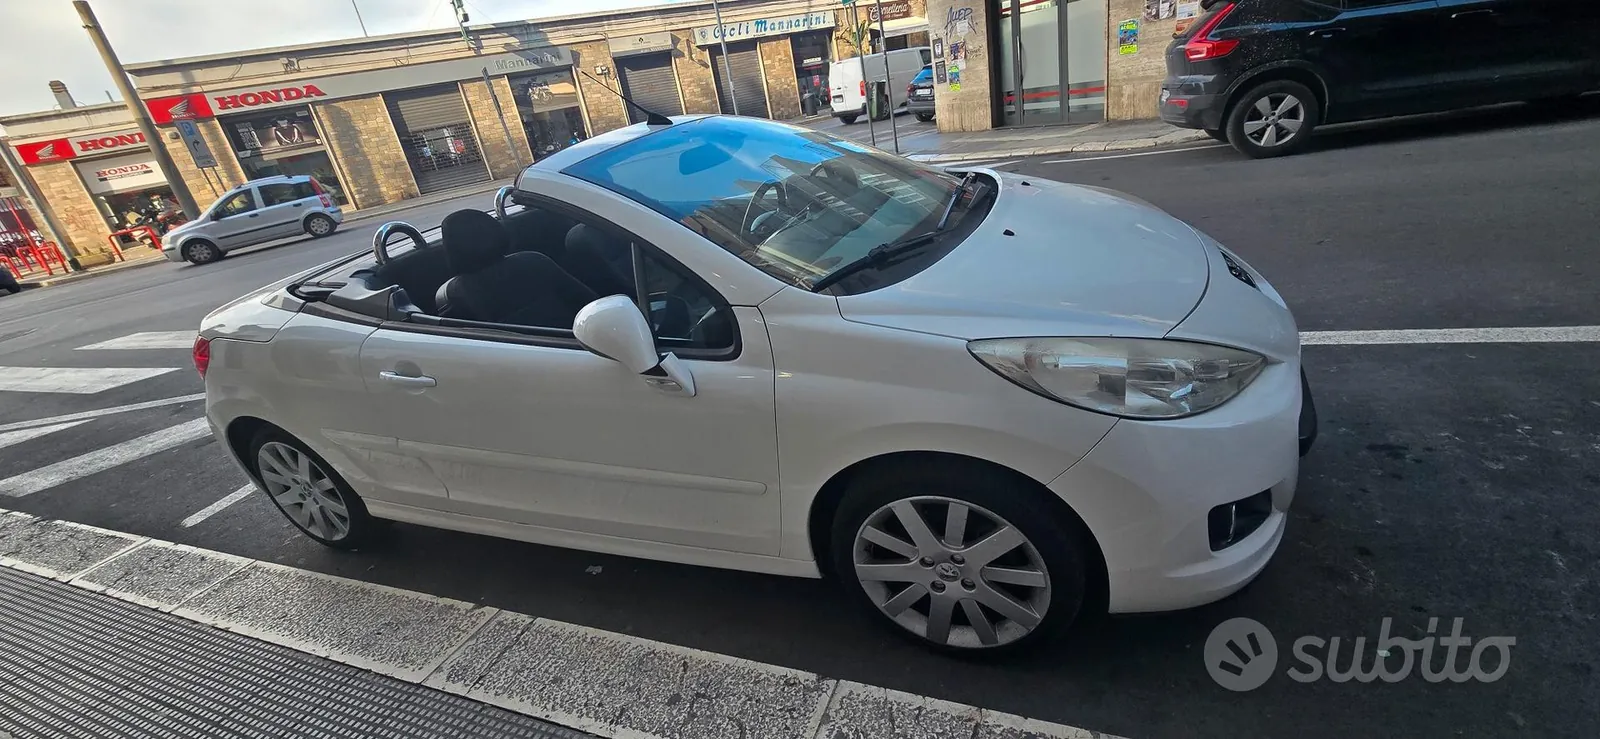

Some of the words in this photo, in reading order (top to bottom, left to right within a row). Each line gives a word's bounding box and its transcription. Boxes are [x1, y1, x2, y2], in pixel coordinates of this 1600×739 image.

[713, 22, 749, 39] Cicli
[754, 12, 827, 33] Mannarini
[493, 51, 562, 70] Mannarini
[213, 83, 327, 110] HONDA
[95, 163, 151, 177] HONDA
